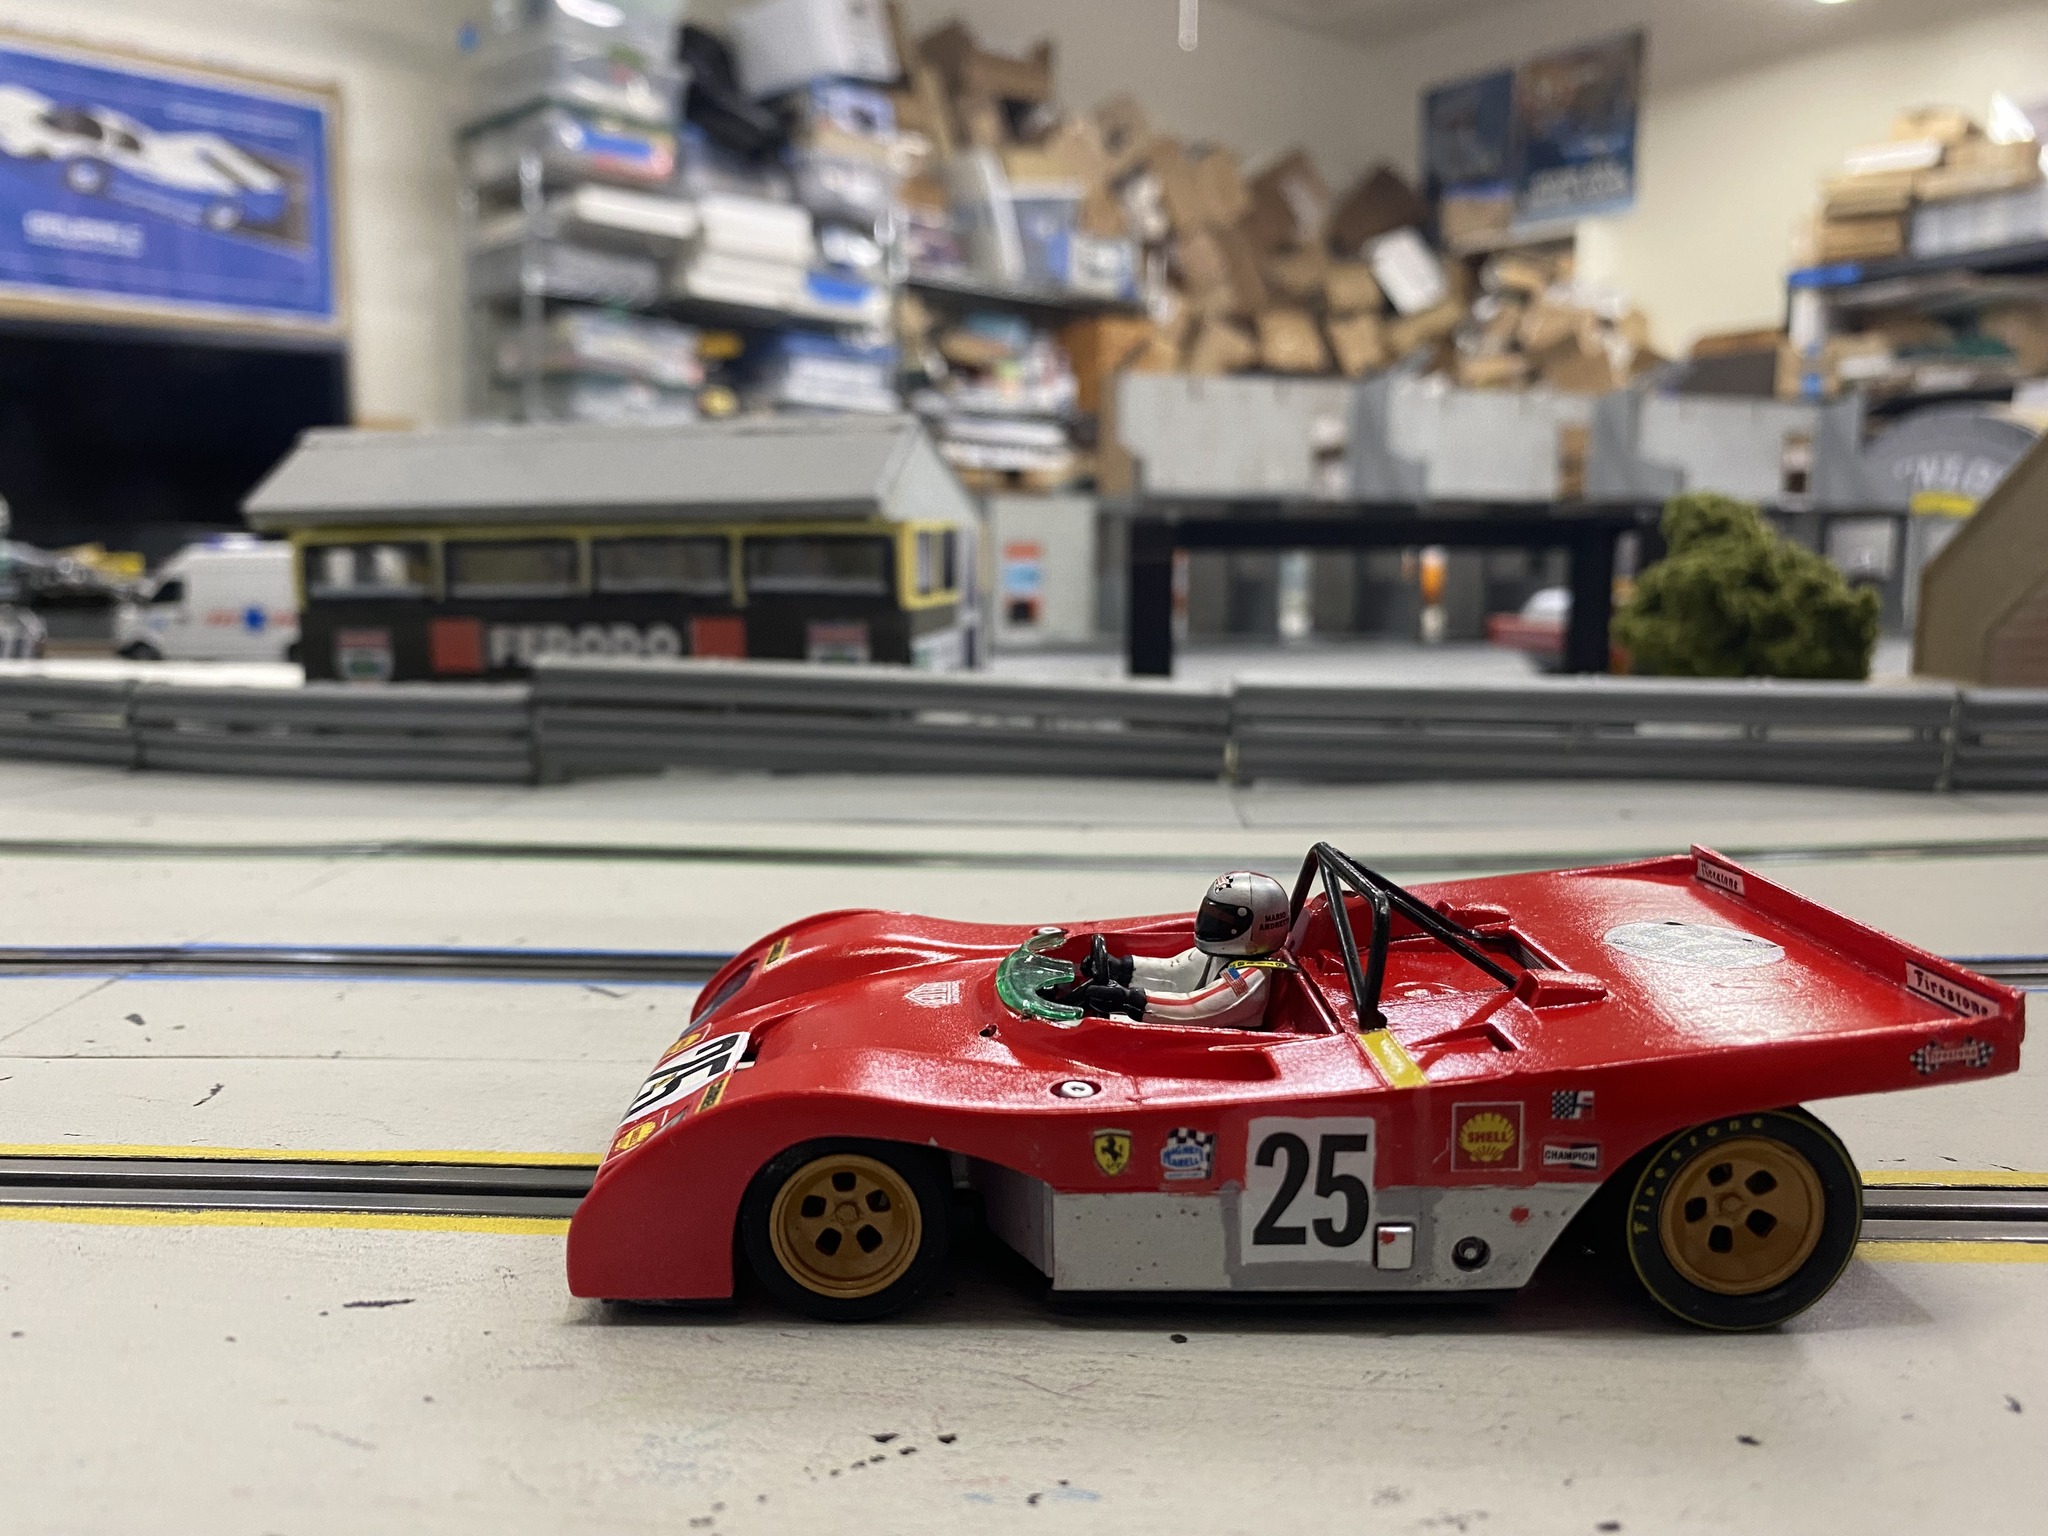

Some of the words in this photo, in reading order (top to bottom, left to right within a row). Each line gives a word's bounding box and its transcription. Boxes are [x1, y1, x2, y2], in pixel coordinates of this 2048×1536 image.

[1264, 911, 1286, 922] MARIO
[1914, 969, 1988, 1015] Firestone
[1467, 1131, 1508, 1143] SHELL
[1545, 1150, 1596, 1161] CHAMPION
[1252, 1132, 1370, 1247] 25
